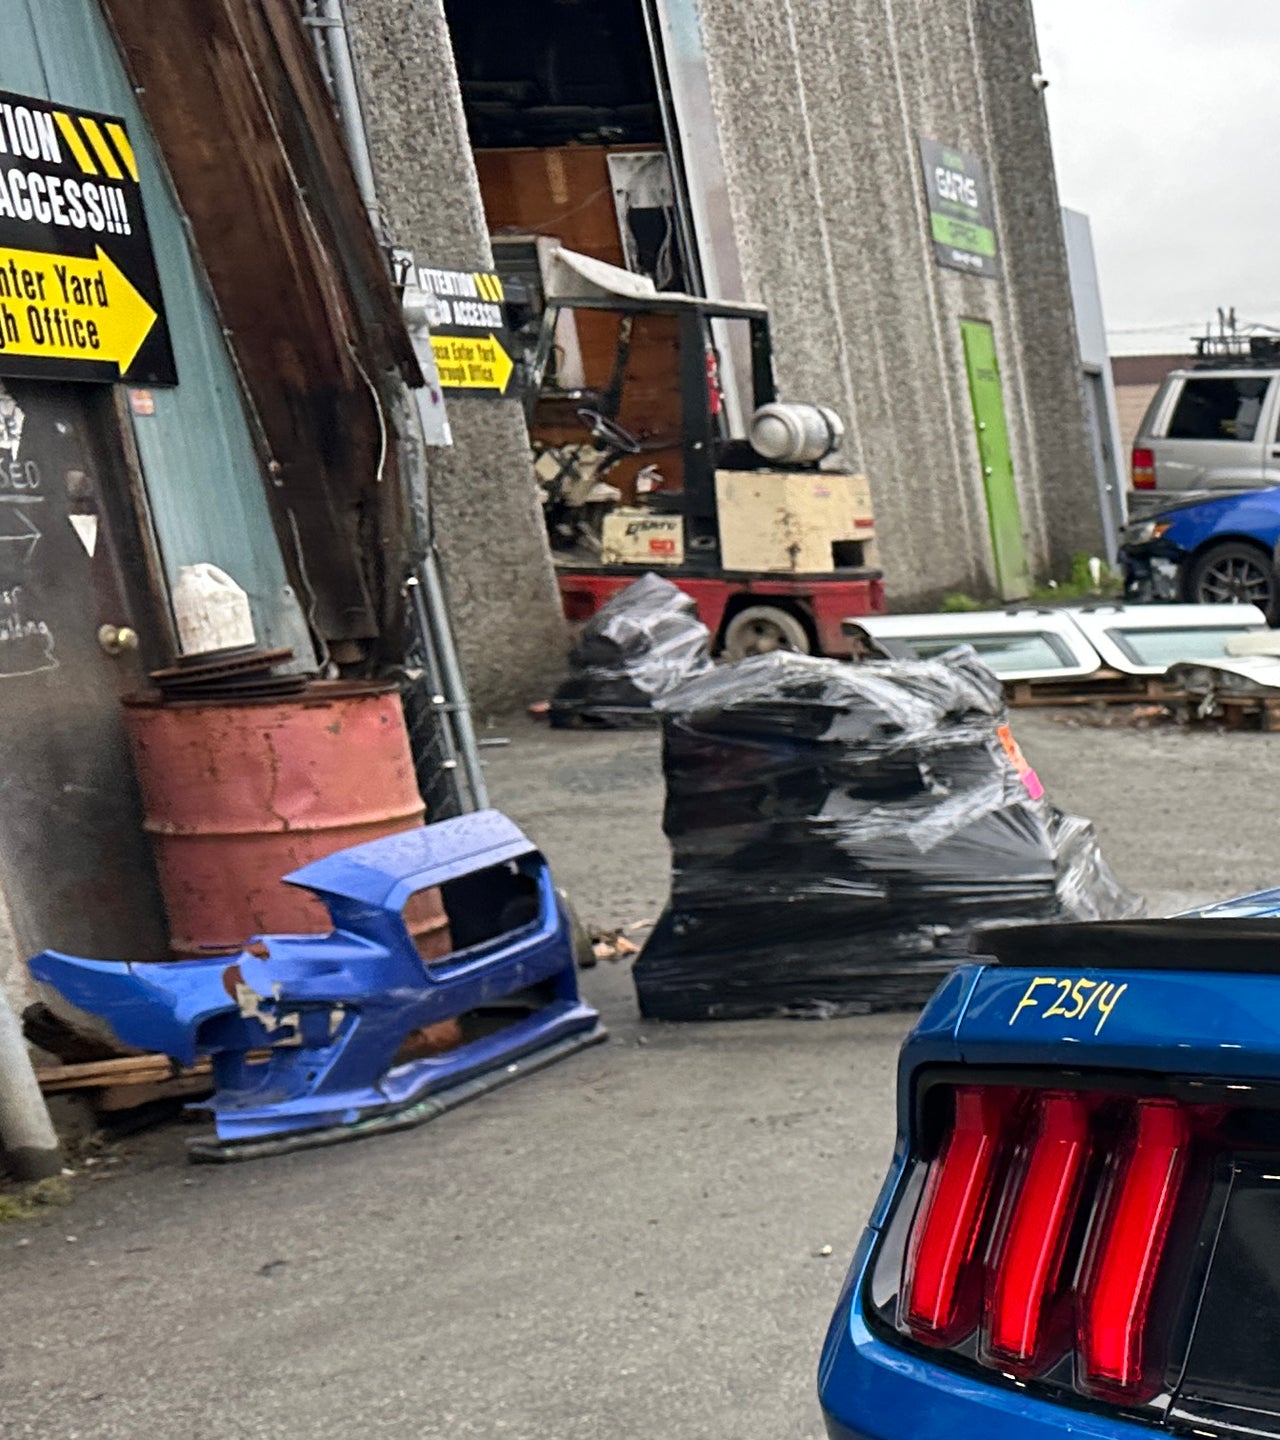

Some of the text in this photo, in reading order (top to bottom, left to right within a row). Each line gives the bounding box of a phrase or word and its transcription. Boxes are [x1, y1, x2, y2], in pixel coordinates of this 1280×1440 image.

[53, 263, 109, 308] Yard
[26, 304, 100, 350] Office
[1007, 976, 1129, 1037] F2514
